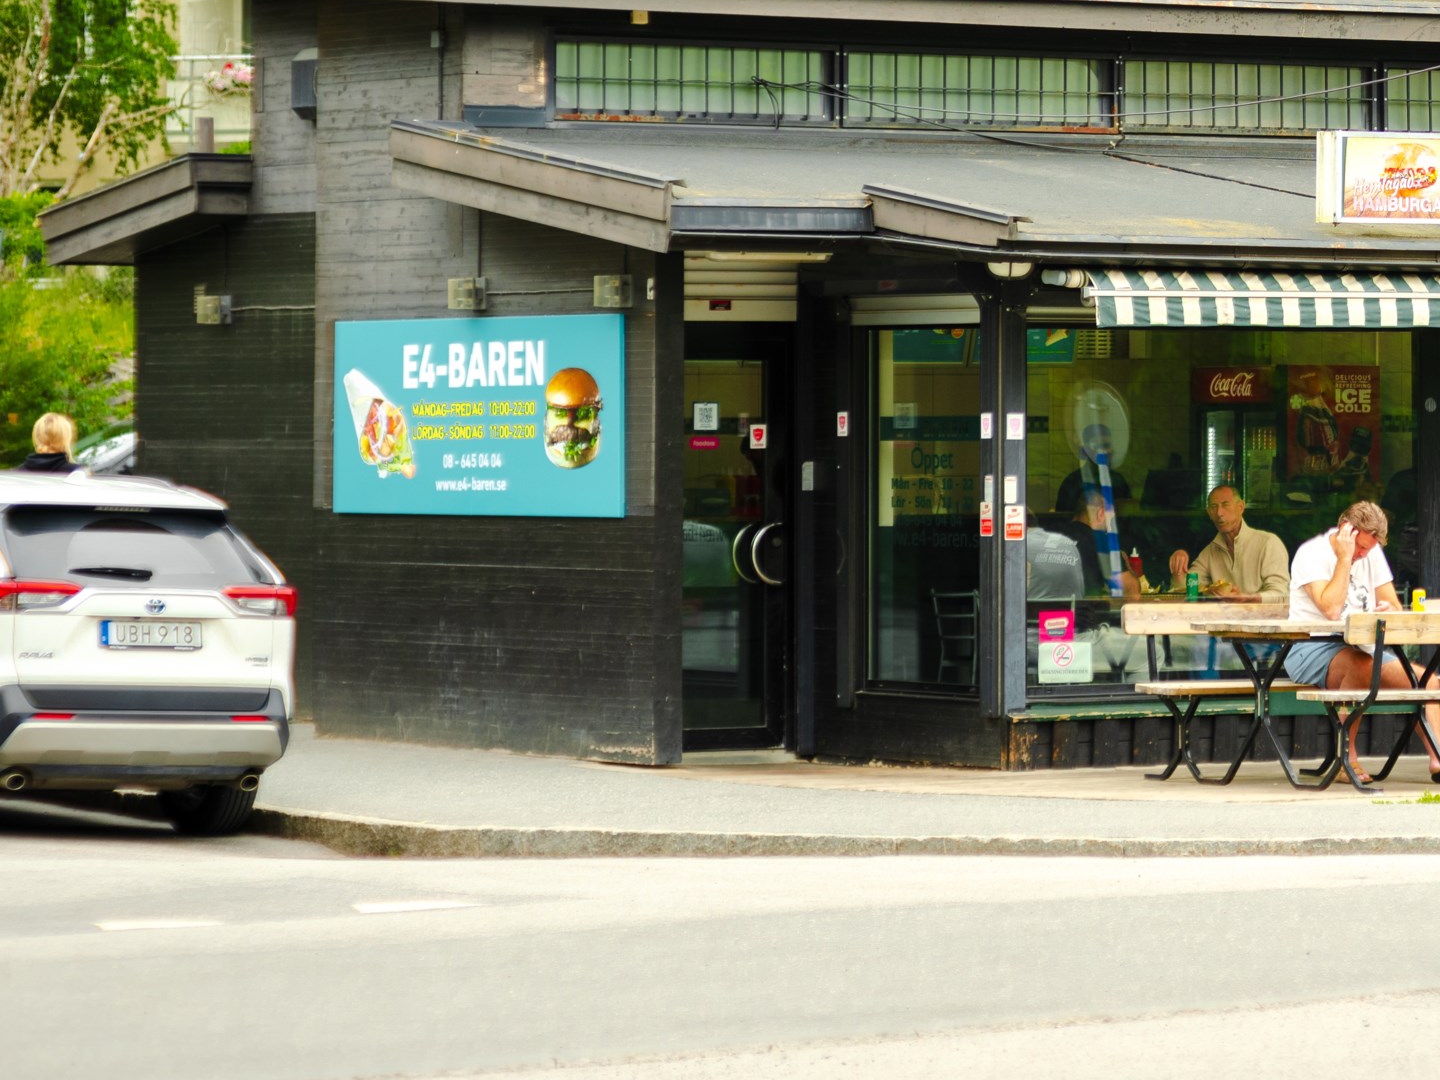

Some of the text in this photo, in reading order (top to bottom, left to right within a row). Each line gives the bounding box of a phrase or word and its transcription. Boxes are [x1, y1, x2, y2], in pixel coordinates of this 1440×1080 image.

[403, 340, 545, 389] E4-BAREN
[1210, 373, 1255, 397] Coca-Cola
[1335, 388, 1372, 404] ICE
[1335, 404, 1371, 413] COLD
[435, 477, 507, 491] www.e4-baren.se
[116, 625, 194, 644] UBH 918
